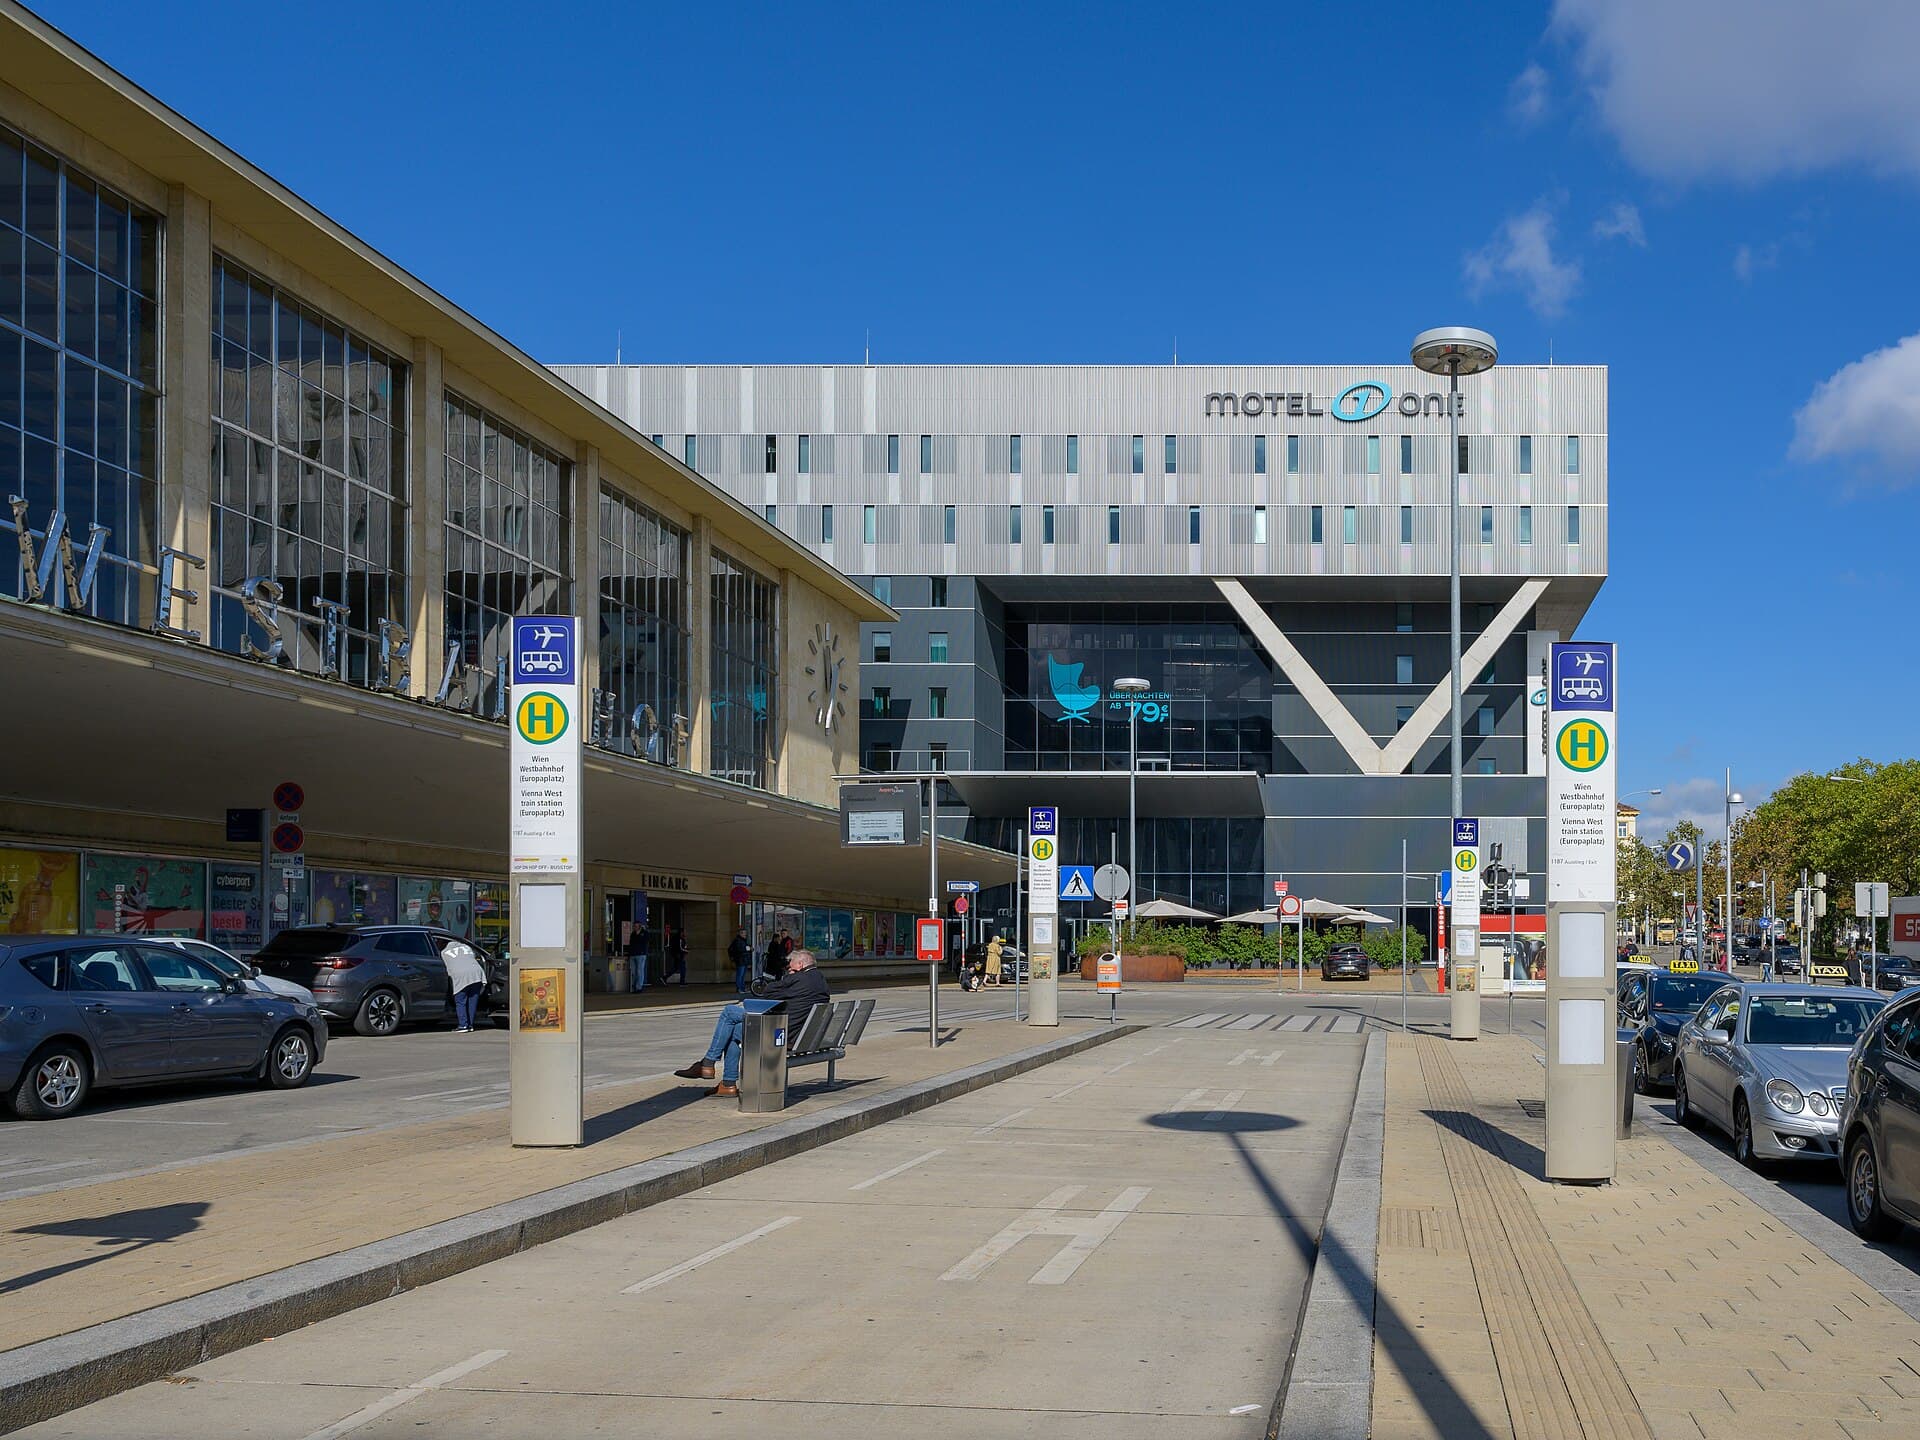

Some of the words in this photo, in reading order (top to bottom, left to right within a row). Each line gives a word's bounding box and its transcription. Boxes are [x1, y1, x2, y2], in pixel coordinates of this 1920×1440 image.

[1206, 392, 1323, 416] MOTEL
[1110, 702, 1122, 710] AB
[528, 702, 553, 734] H
[1570, 729, 1596, 762] H
[519, 765, 564, 773] Westbahnhof
[519, 775, 565, 784] (Europaplatz)
[1560, 803, 1605, 811] (Europaplatz)
[519, 809, 565, 818] (Europaplatz)
[1560, 837, 1605, 846] (Europaplatz)
[1037, 842, 1048, 856] H
[1460, 854, 1472, 867] H
[216, 875, 251, 888] cyberport
[641, 873, 689, 890] EINGANG
[212, 915, 242, 929] beste
[1672, 961, 1697, 969] TAXI
[1813, 967, 1845, 975] TAXI
